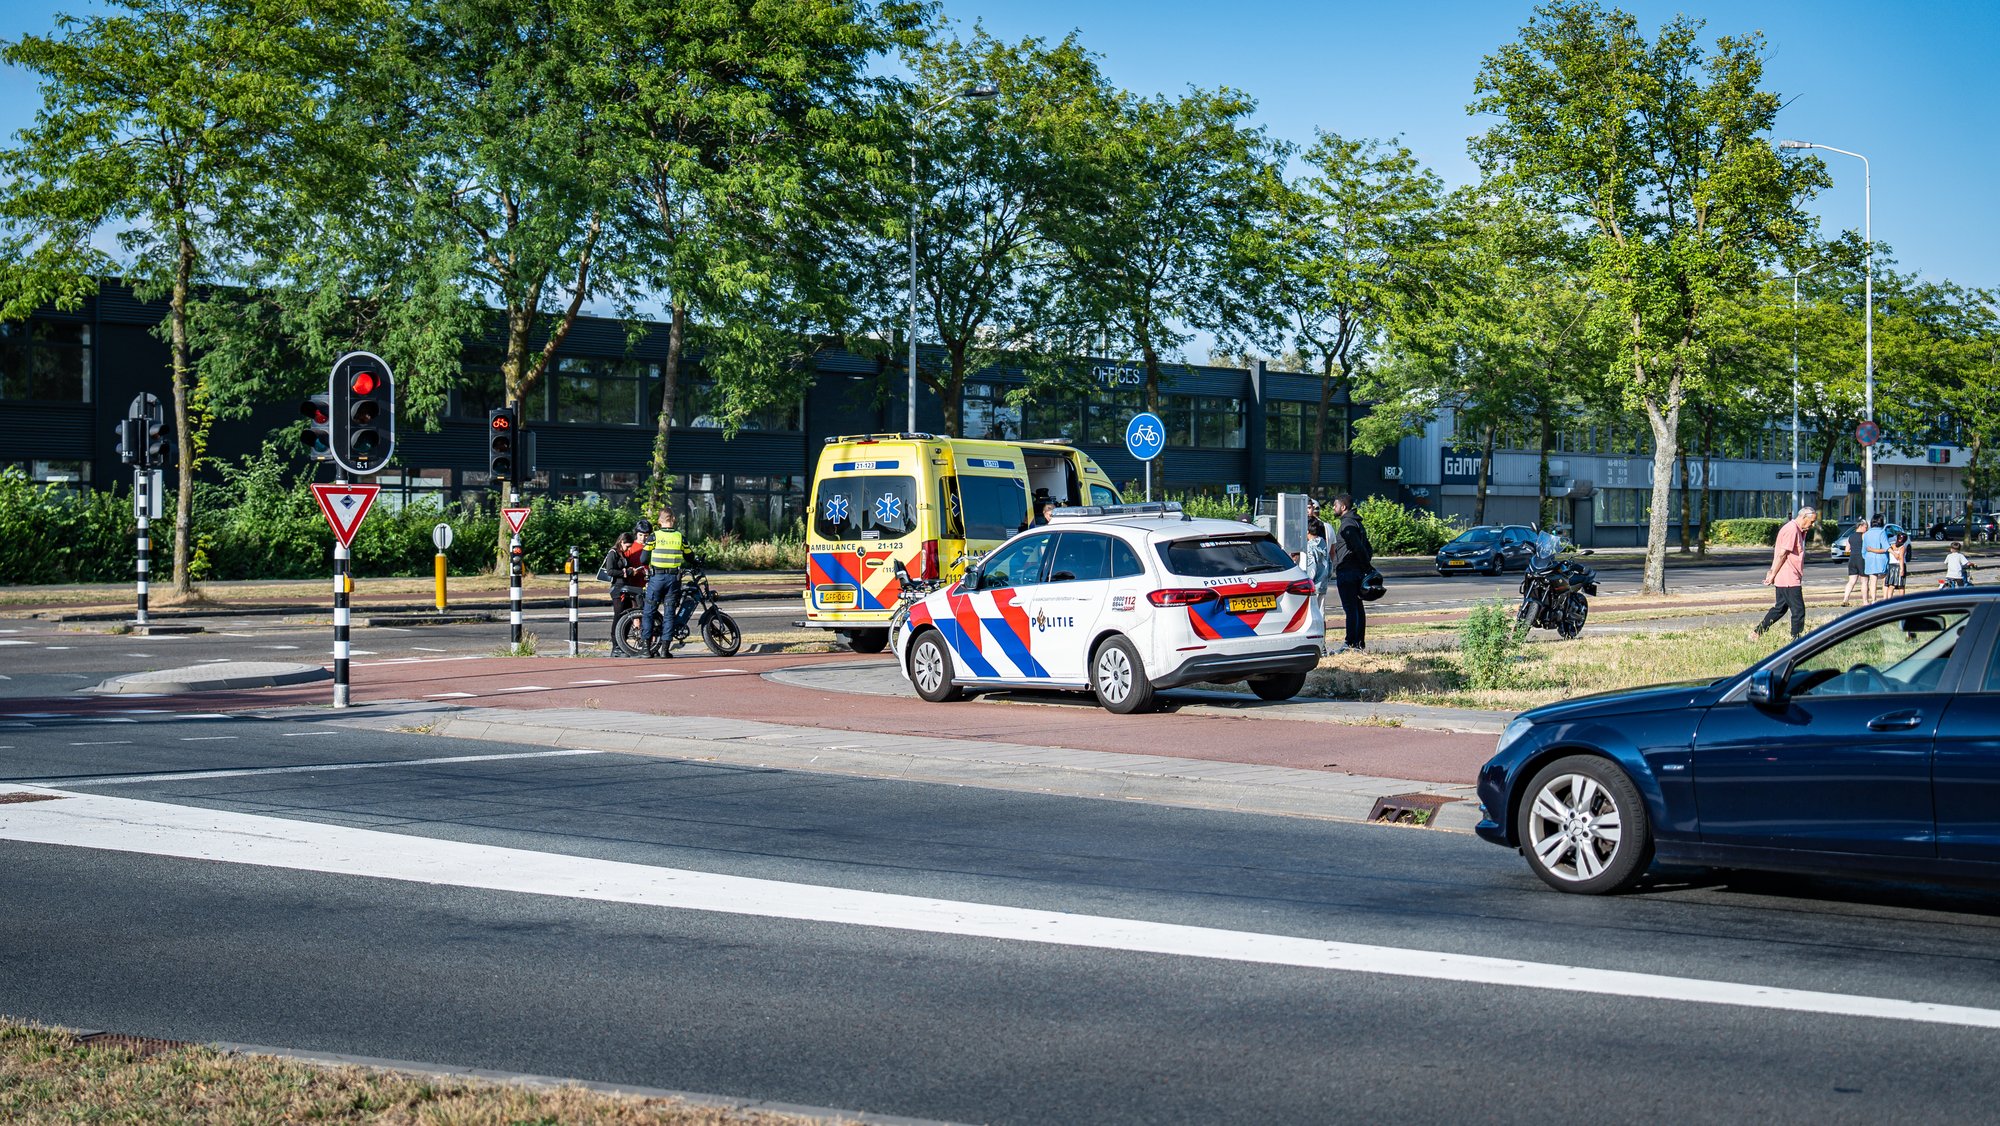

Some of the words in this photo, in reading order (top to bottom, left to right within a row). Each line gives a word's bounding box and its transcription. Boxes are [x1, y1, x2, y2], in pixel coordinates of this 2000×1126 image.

[1092, 366, 1140, 384] OFFICES
[810, 543, 856, 551] AMBULANCE
[1203, 577, 1244, 587] POLITIE
[1125, 596, 1136, 605] 112
[1232, 597, 1273, 609] P-988-LR
